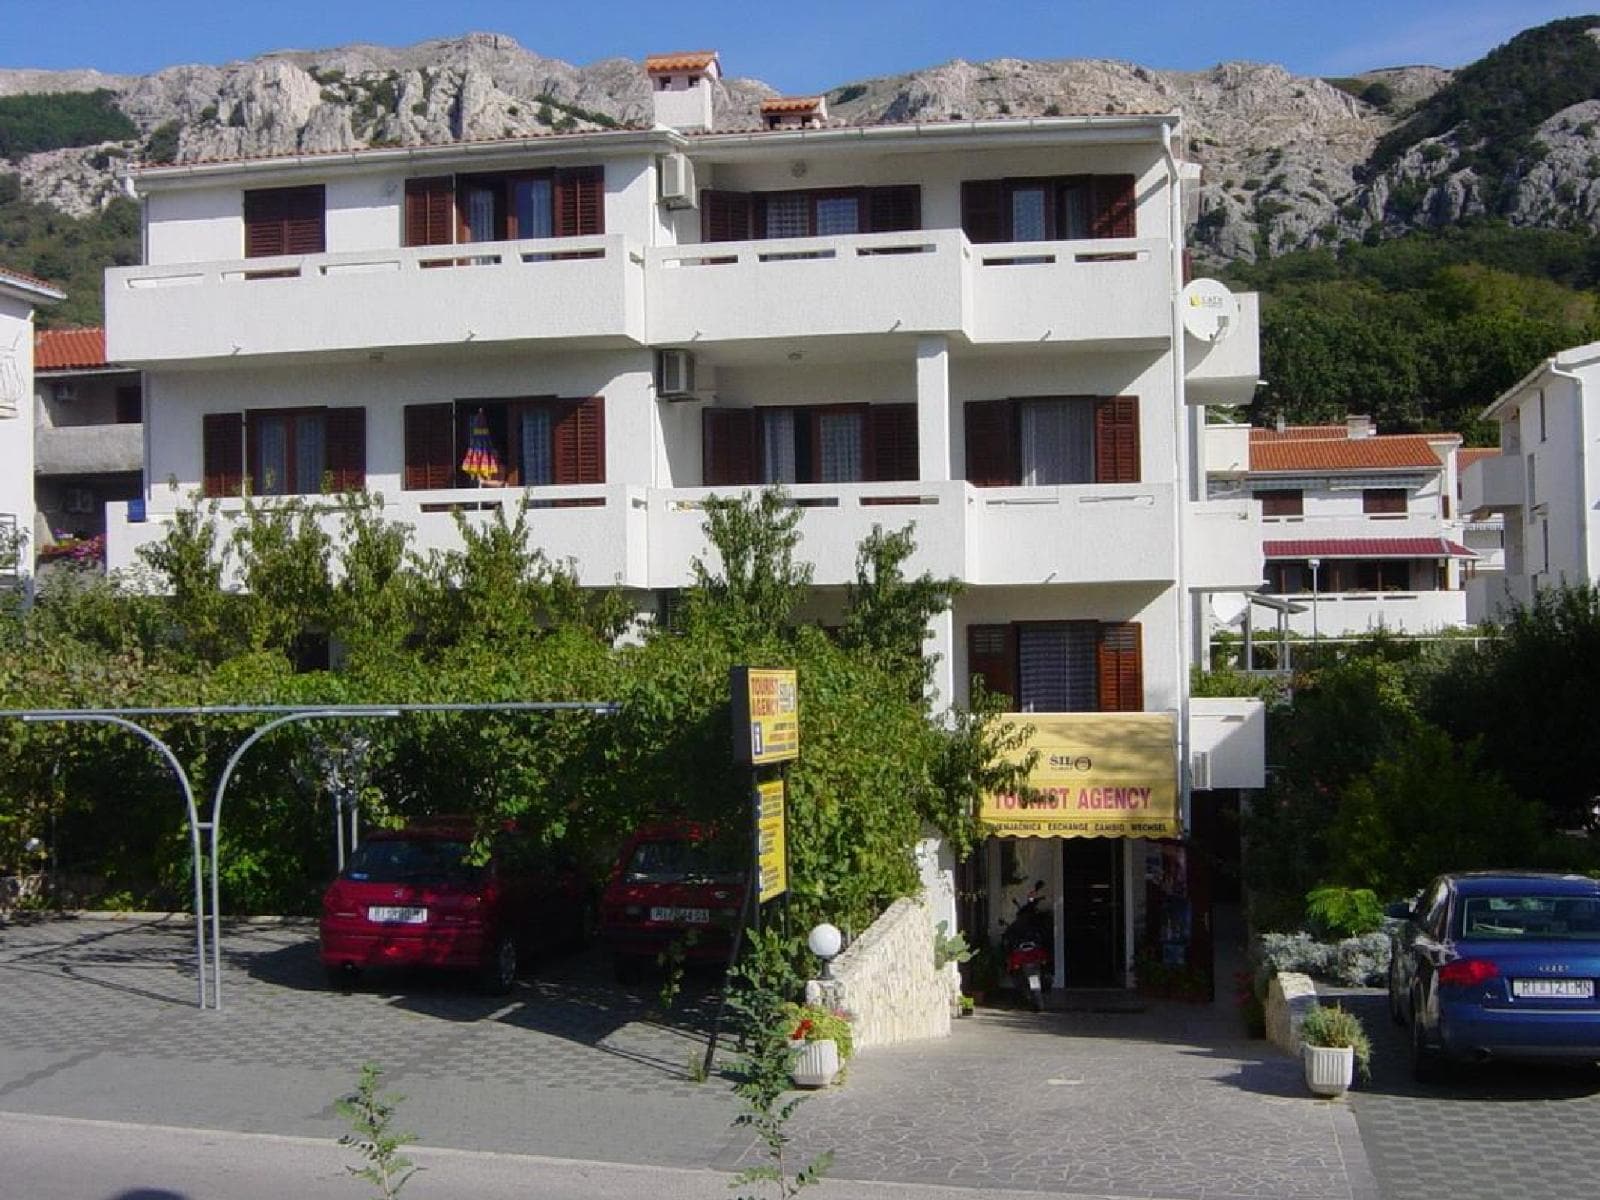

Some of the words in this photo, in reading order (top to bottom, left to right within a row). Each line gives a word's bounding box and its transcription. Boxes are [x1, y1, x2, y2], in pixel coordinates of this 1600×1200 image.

[1077, 786, 1153, 810] AGENCY
[1047, 822, 1089, 831] EXCHANGE
[1094, 822, 1125, 832] CAMBIO
[1131, 823, 1168, 832] WECHSEL
